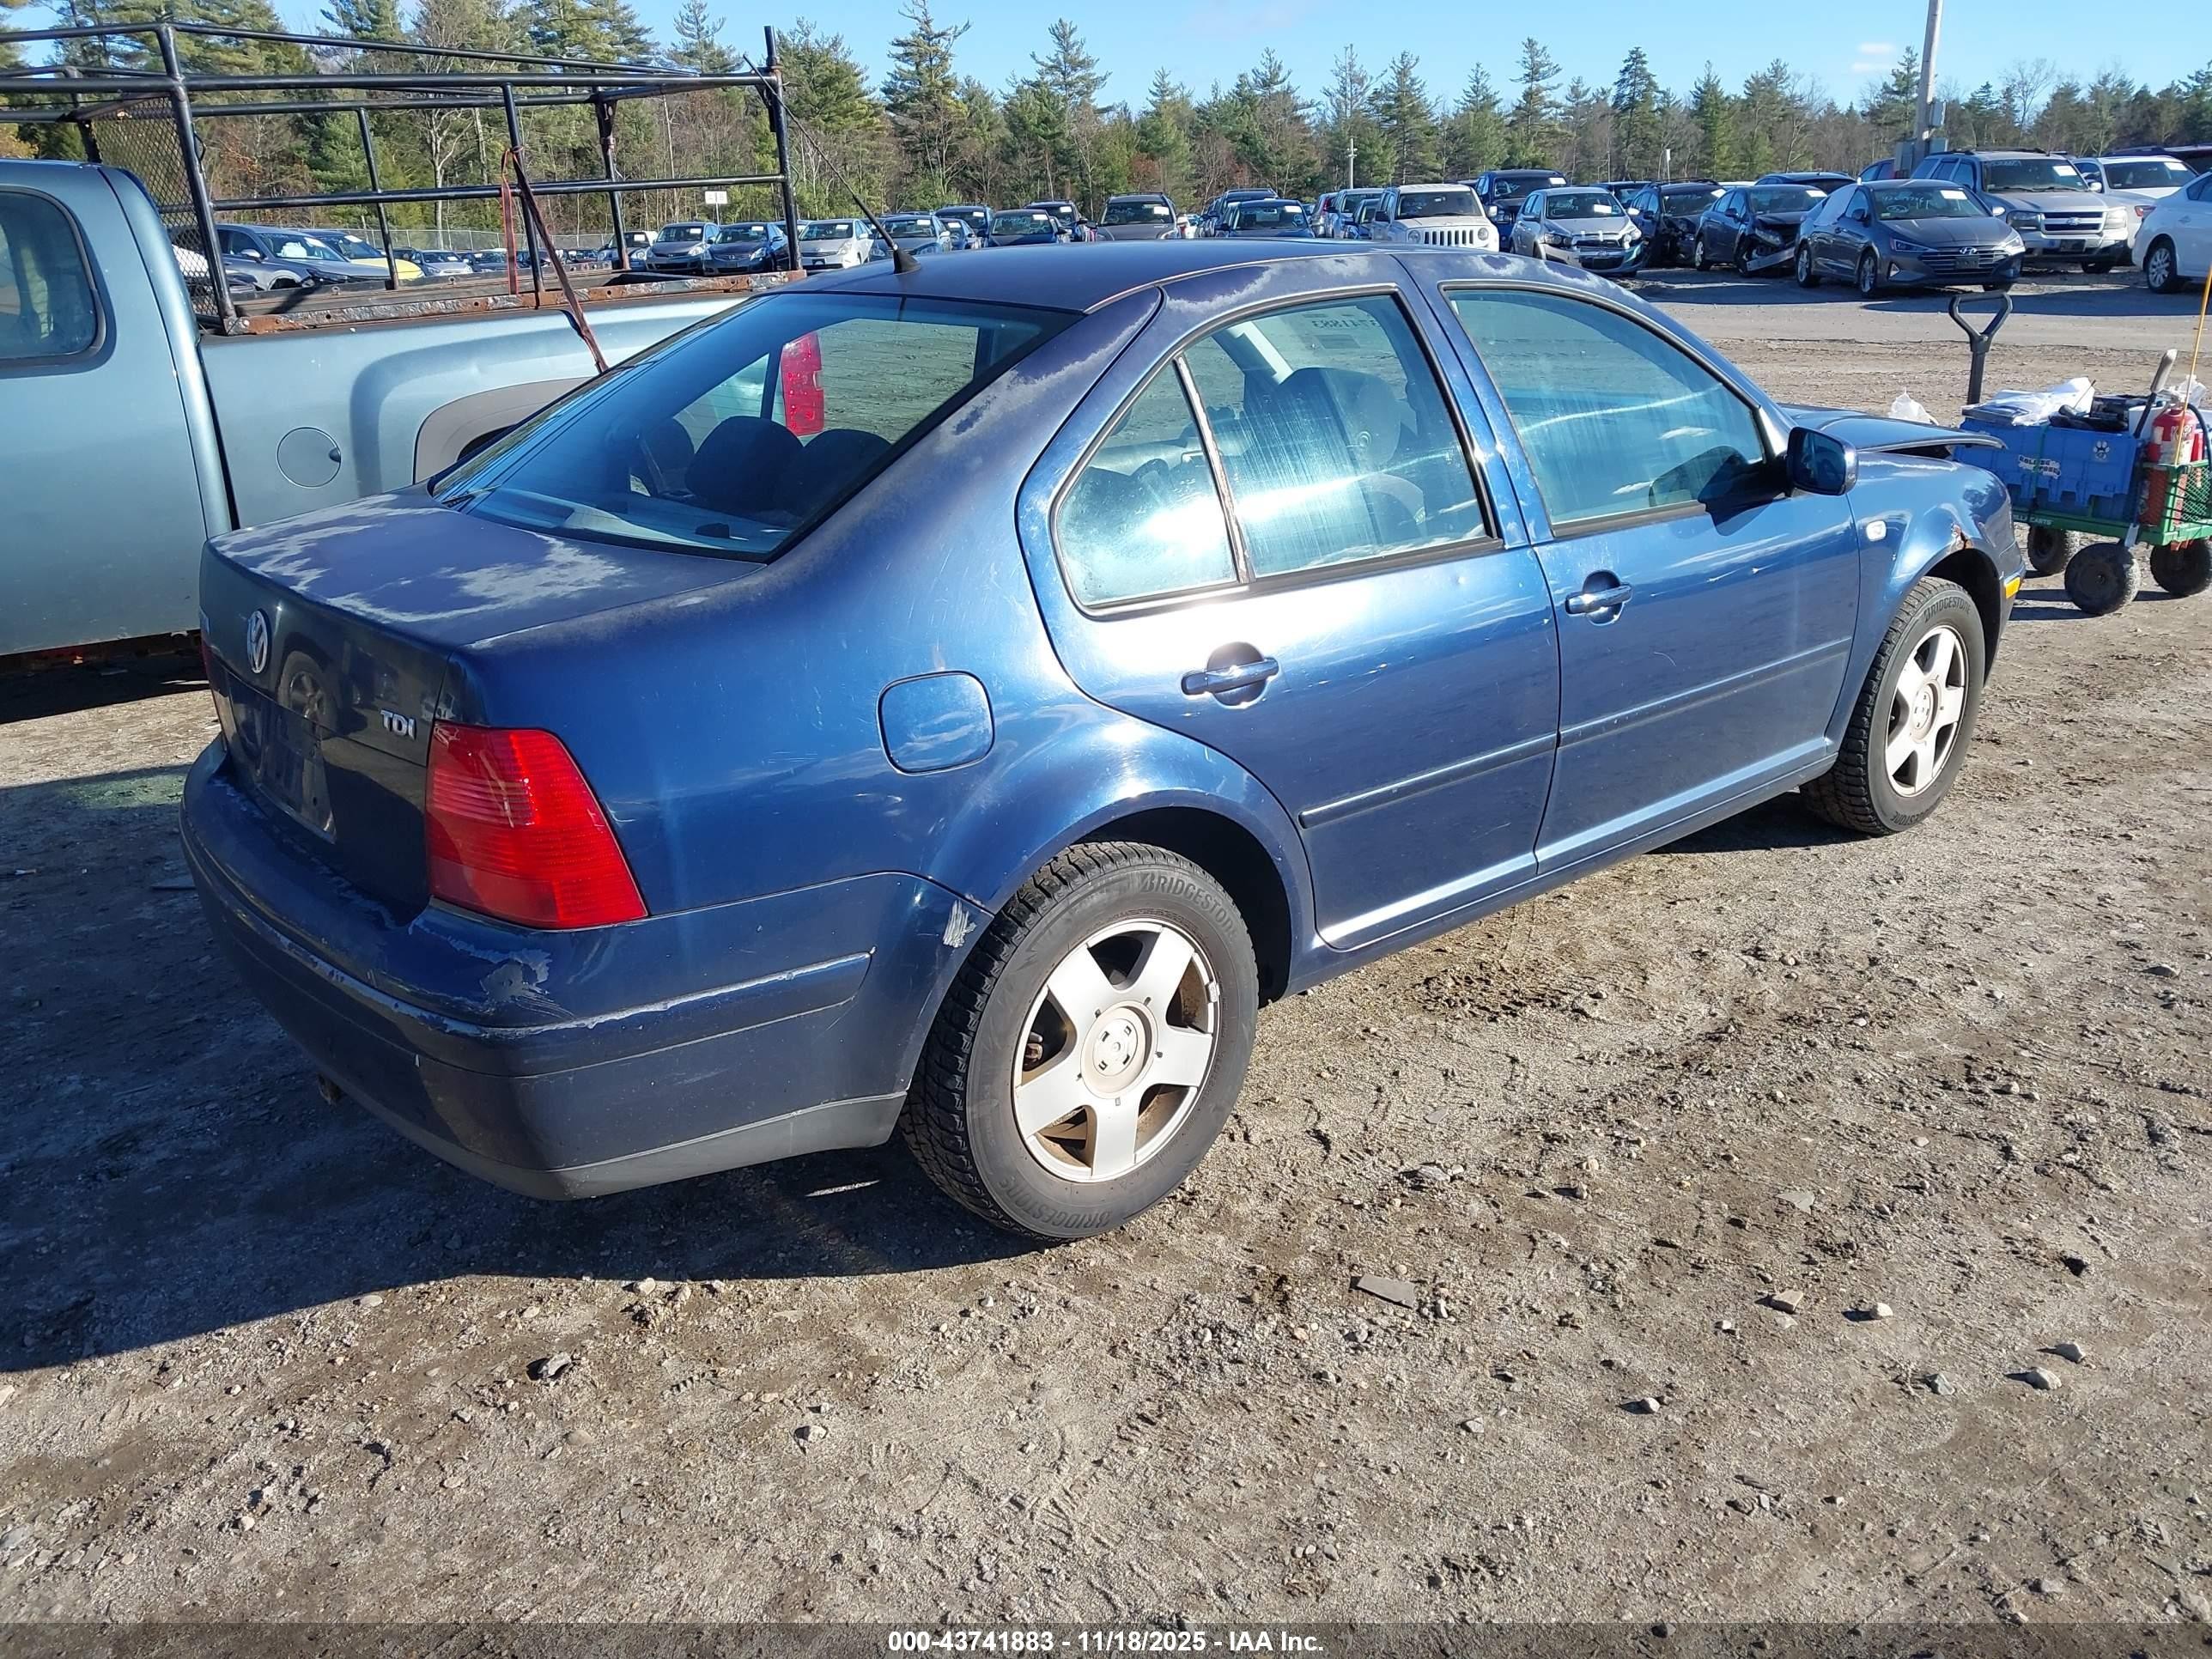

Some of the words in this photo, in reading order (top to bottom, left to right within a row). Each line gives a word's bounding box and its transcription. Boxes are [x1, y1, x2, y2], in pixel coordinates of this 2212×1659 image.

[380, 709, 417, 740] TDI
[1139, 871, 1238, 939] BRIDGESTONE
[997, 1175, 1114, 1230] BRIDGESTONE
